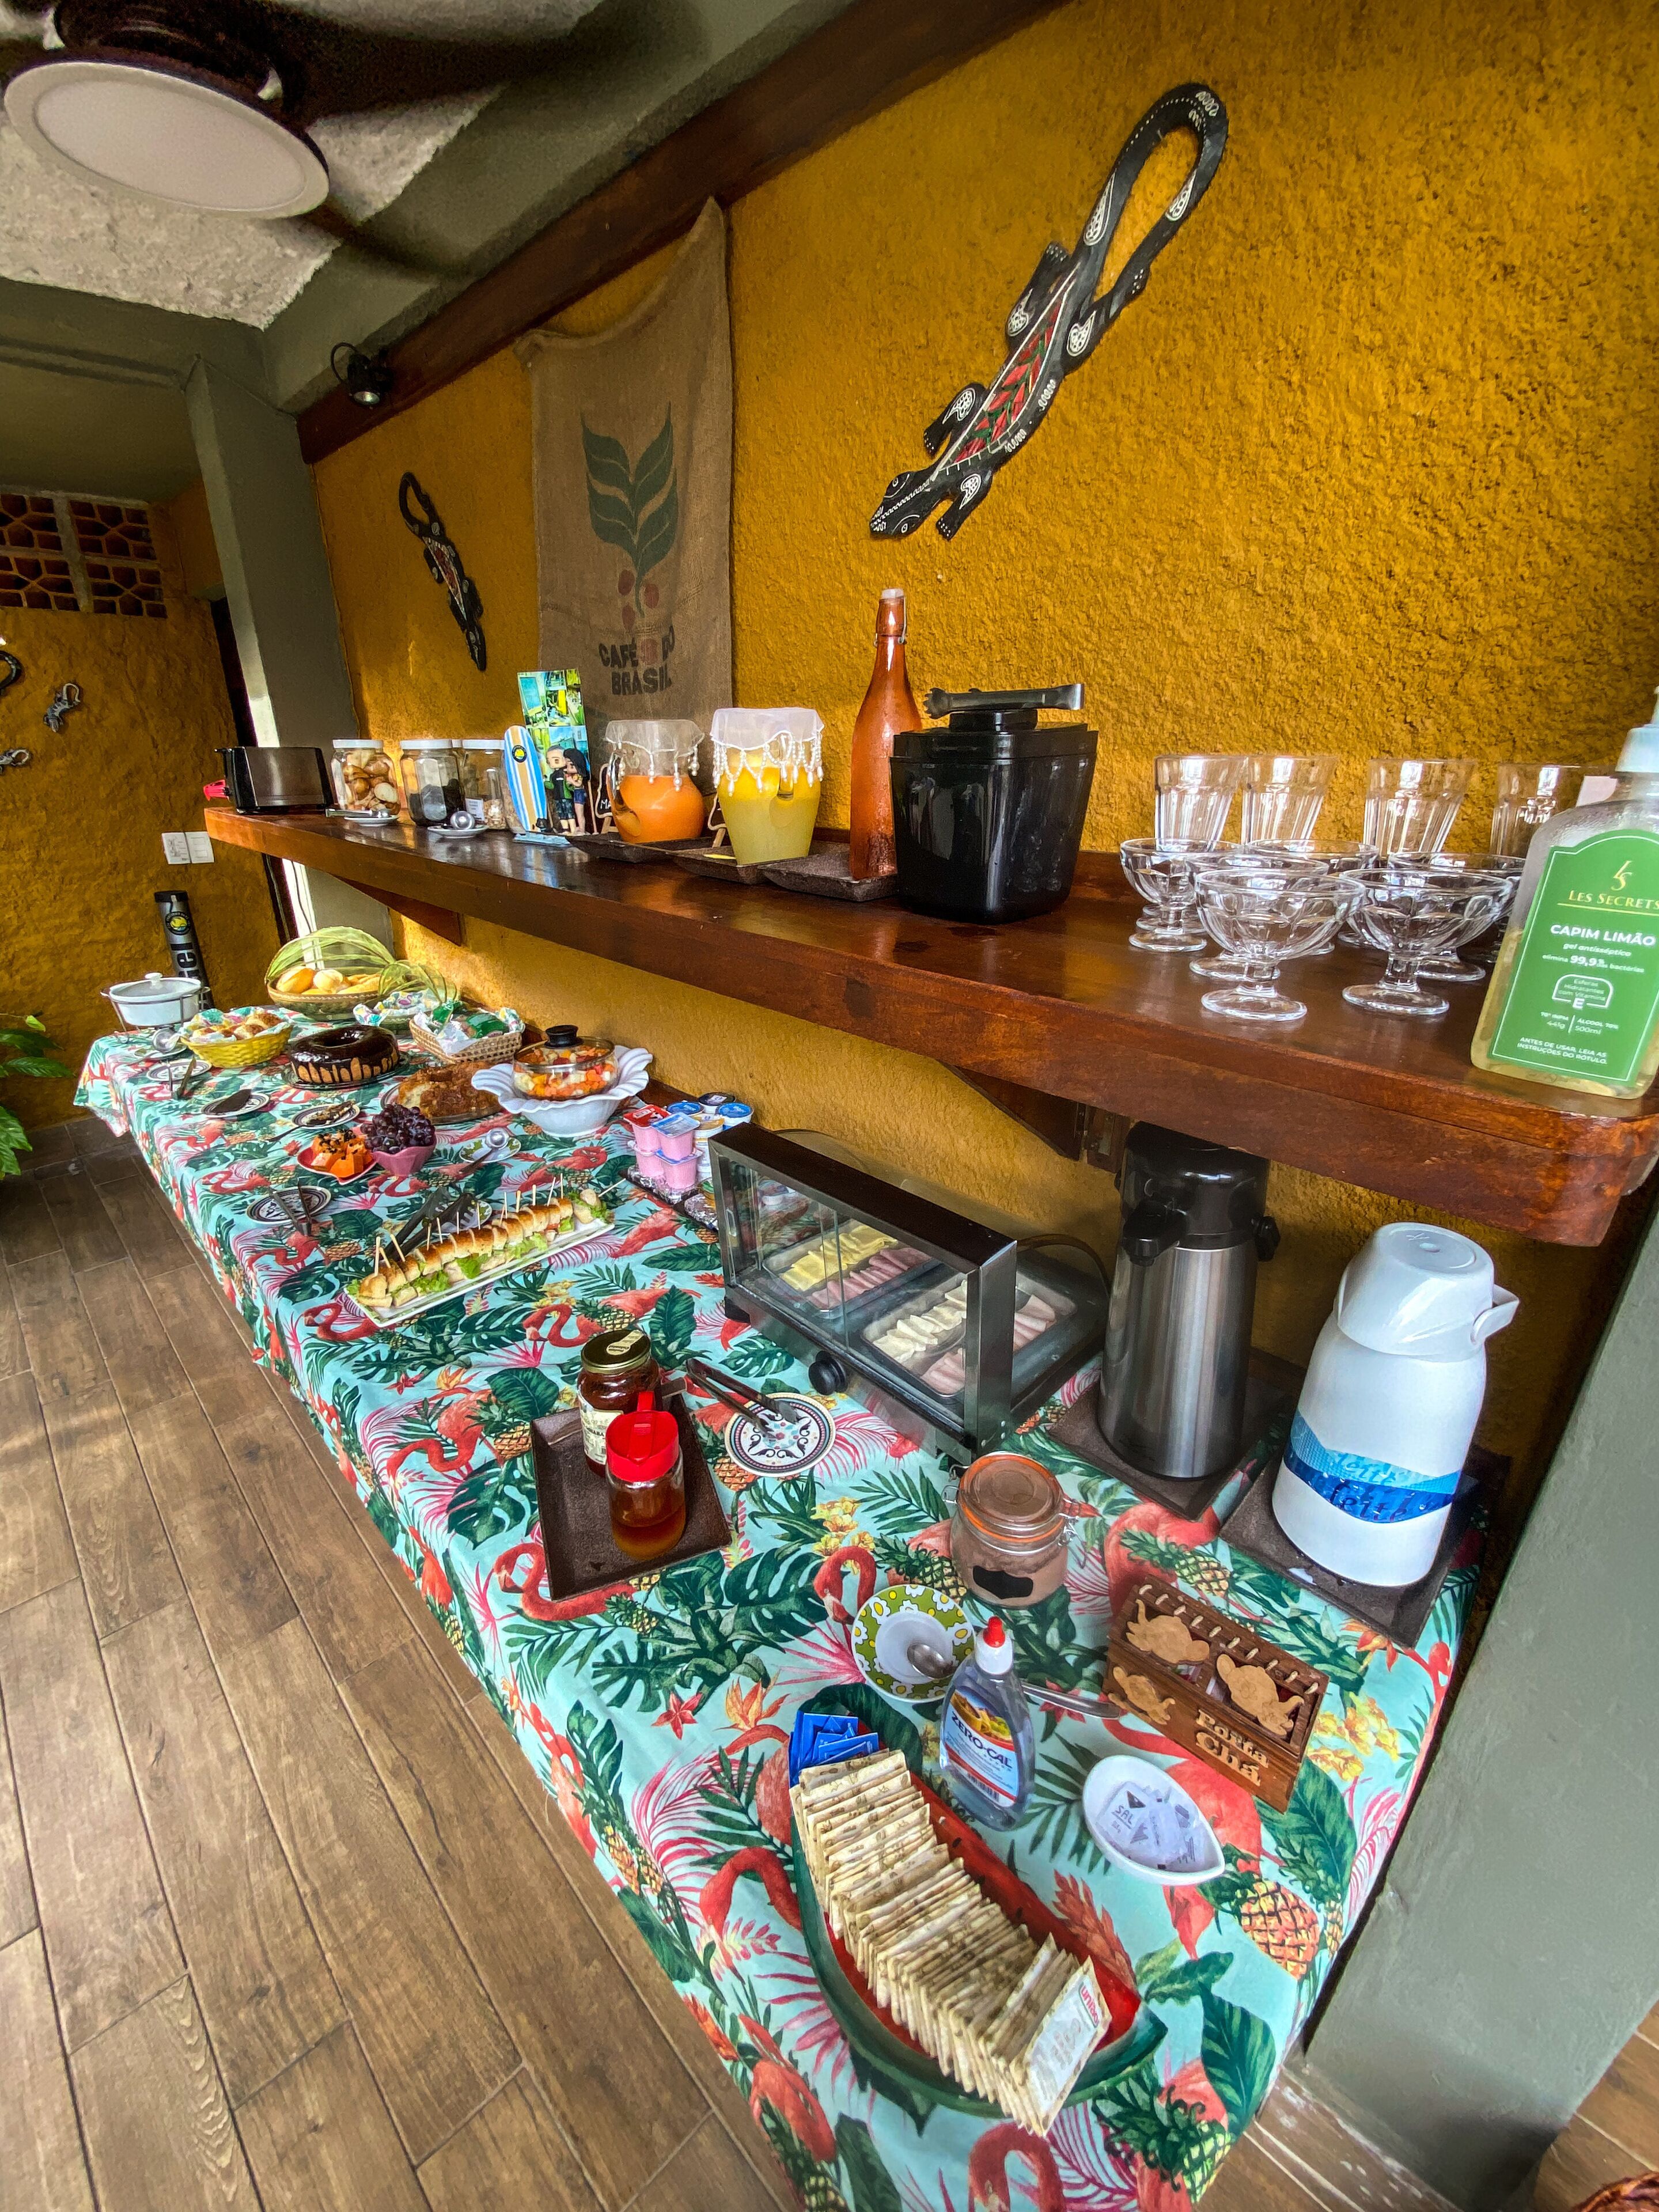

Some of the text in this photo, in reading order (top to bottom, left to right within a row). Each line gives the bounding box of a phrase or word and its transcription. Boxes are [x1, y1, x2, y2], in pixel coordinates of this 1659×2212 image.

[599, 637, 639, 669] CAFÉ
[612, 663, 672, 695] BRASIL
[1568, 890, 1593, 903] LES
[1550, 924, 1656, 946] CAPIM LIMÃO
[1542, 954, 1569, 963] elimina
[1609, 963, 1645, 973] bactérias
[1563, 984, 1605, 994] Hidratantes
[1573, 979, 1599, 987] Esferas
[1572, 998, 1585, 1009] E
[1574, 1025, 1602, 1035] 500ml
[1517, 1043, 1561, 1056] INSTRUÇÕES
[1520, 1037, 1543, 1047] ANTES
[1578, 1048, 1595, 1056] LEIA
[952, 1711, 1013, 1769] ZERO-CAL
[1196, 1709, 1268, 1769] Porta
[1196, 1732, 1261, 1787] Chá
[1115, 1805, 1133, 1825] SAL
